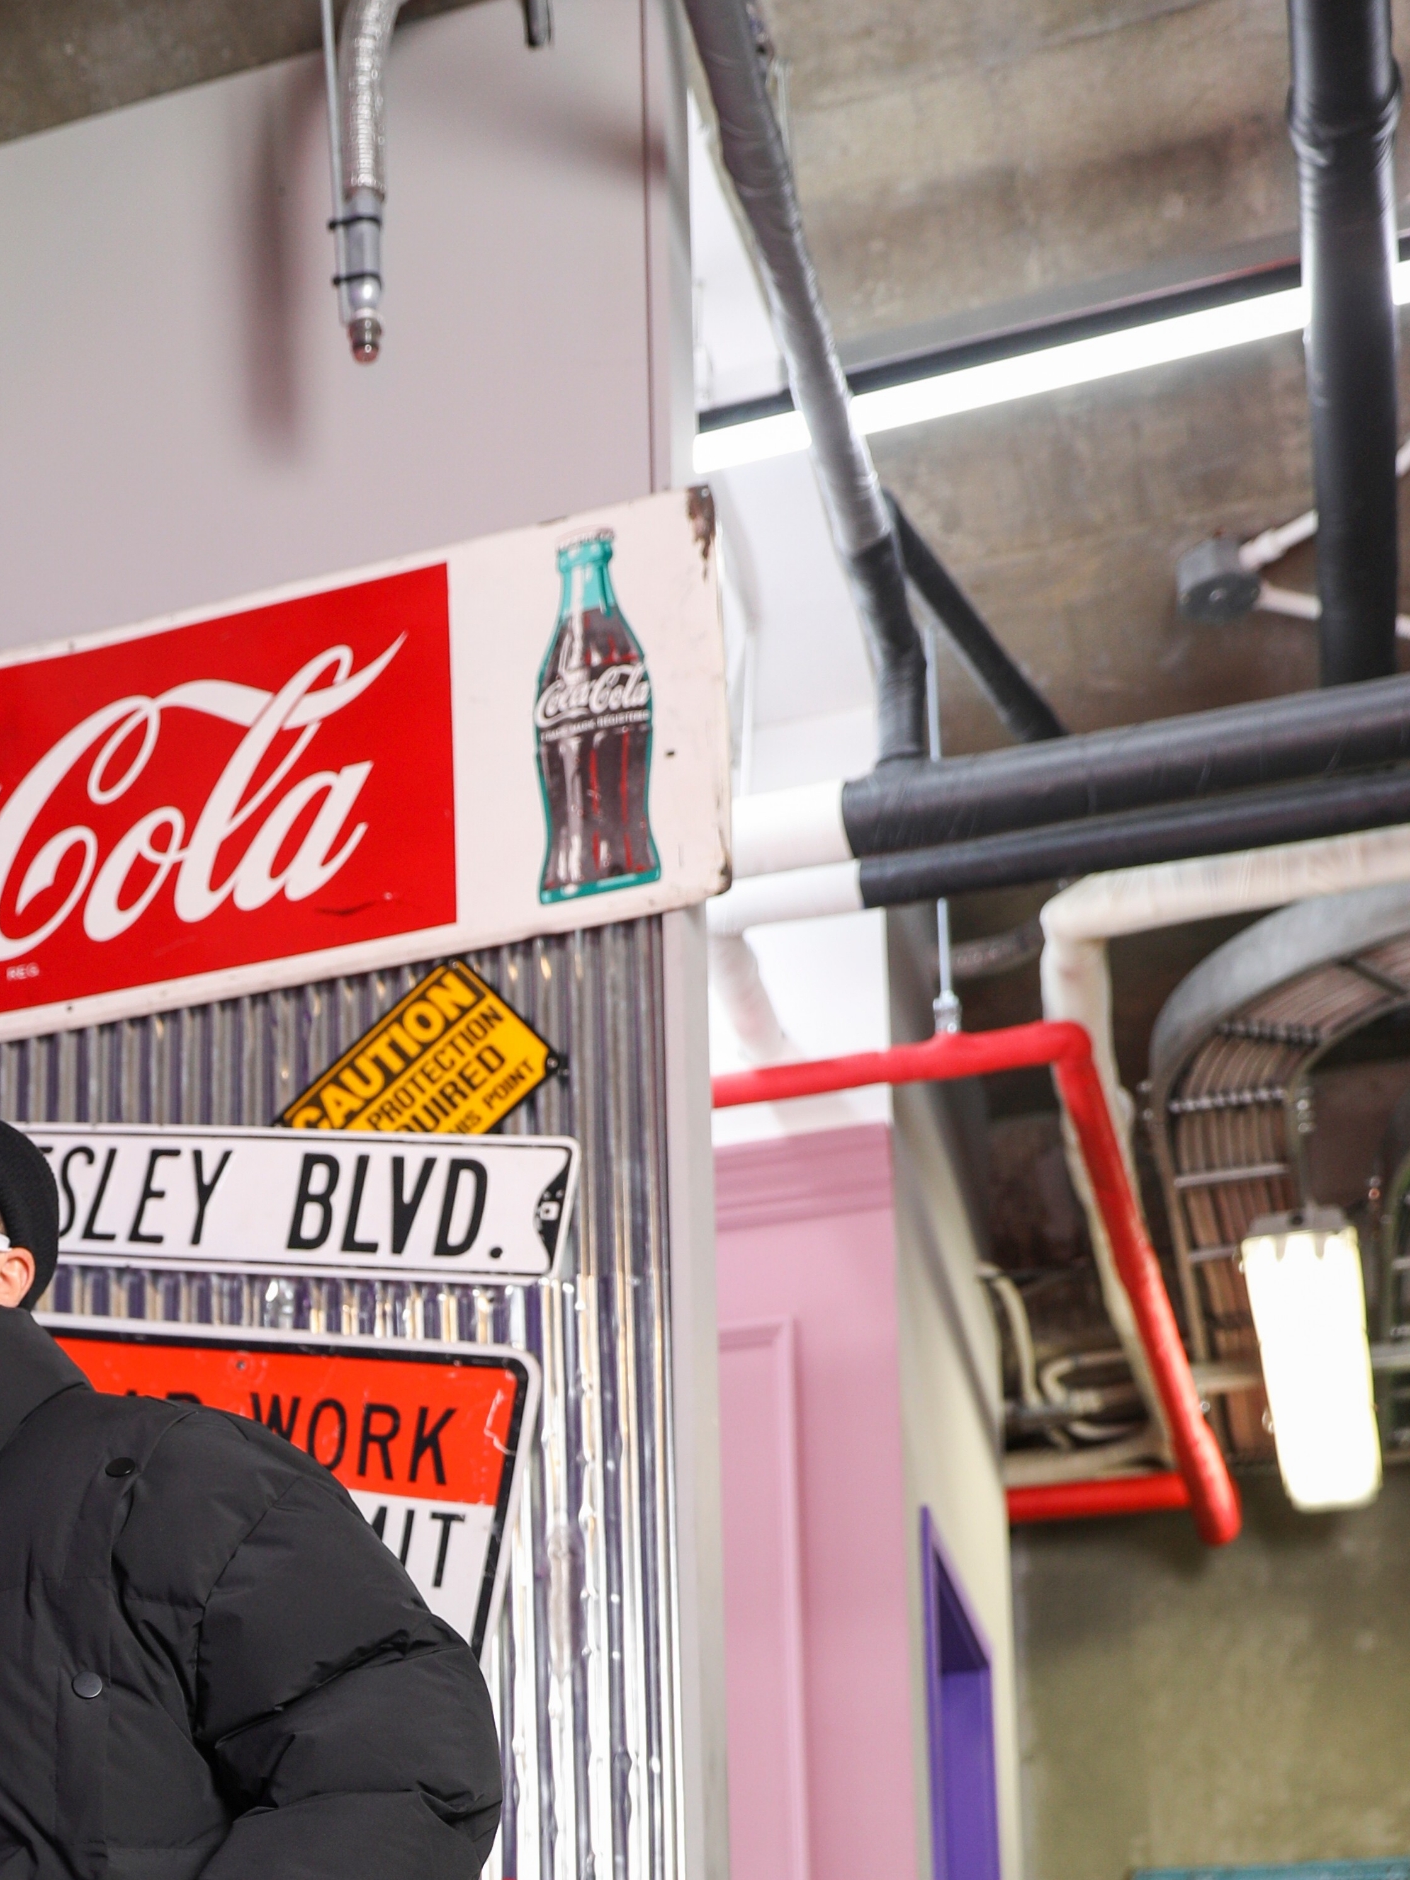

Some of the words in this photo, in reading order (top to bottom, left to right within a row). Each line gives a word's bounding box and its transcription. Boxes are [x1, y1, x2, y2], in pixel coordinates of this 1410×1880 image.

[292, 970, 478, 1130] CAUTION
[365, 1004, 504, 1130] PROTECTION
[482, 1058, 535, 1110] POINT
[42, 1145, 233, 1247] SLEY
[286, 1152, 504, 1259] BLVD.
